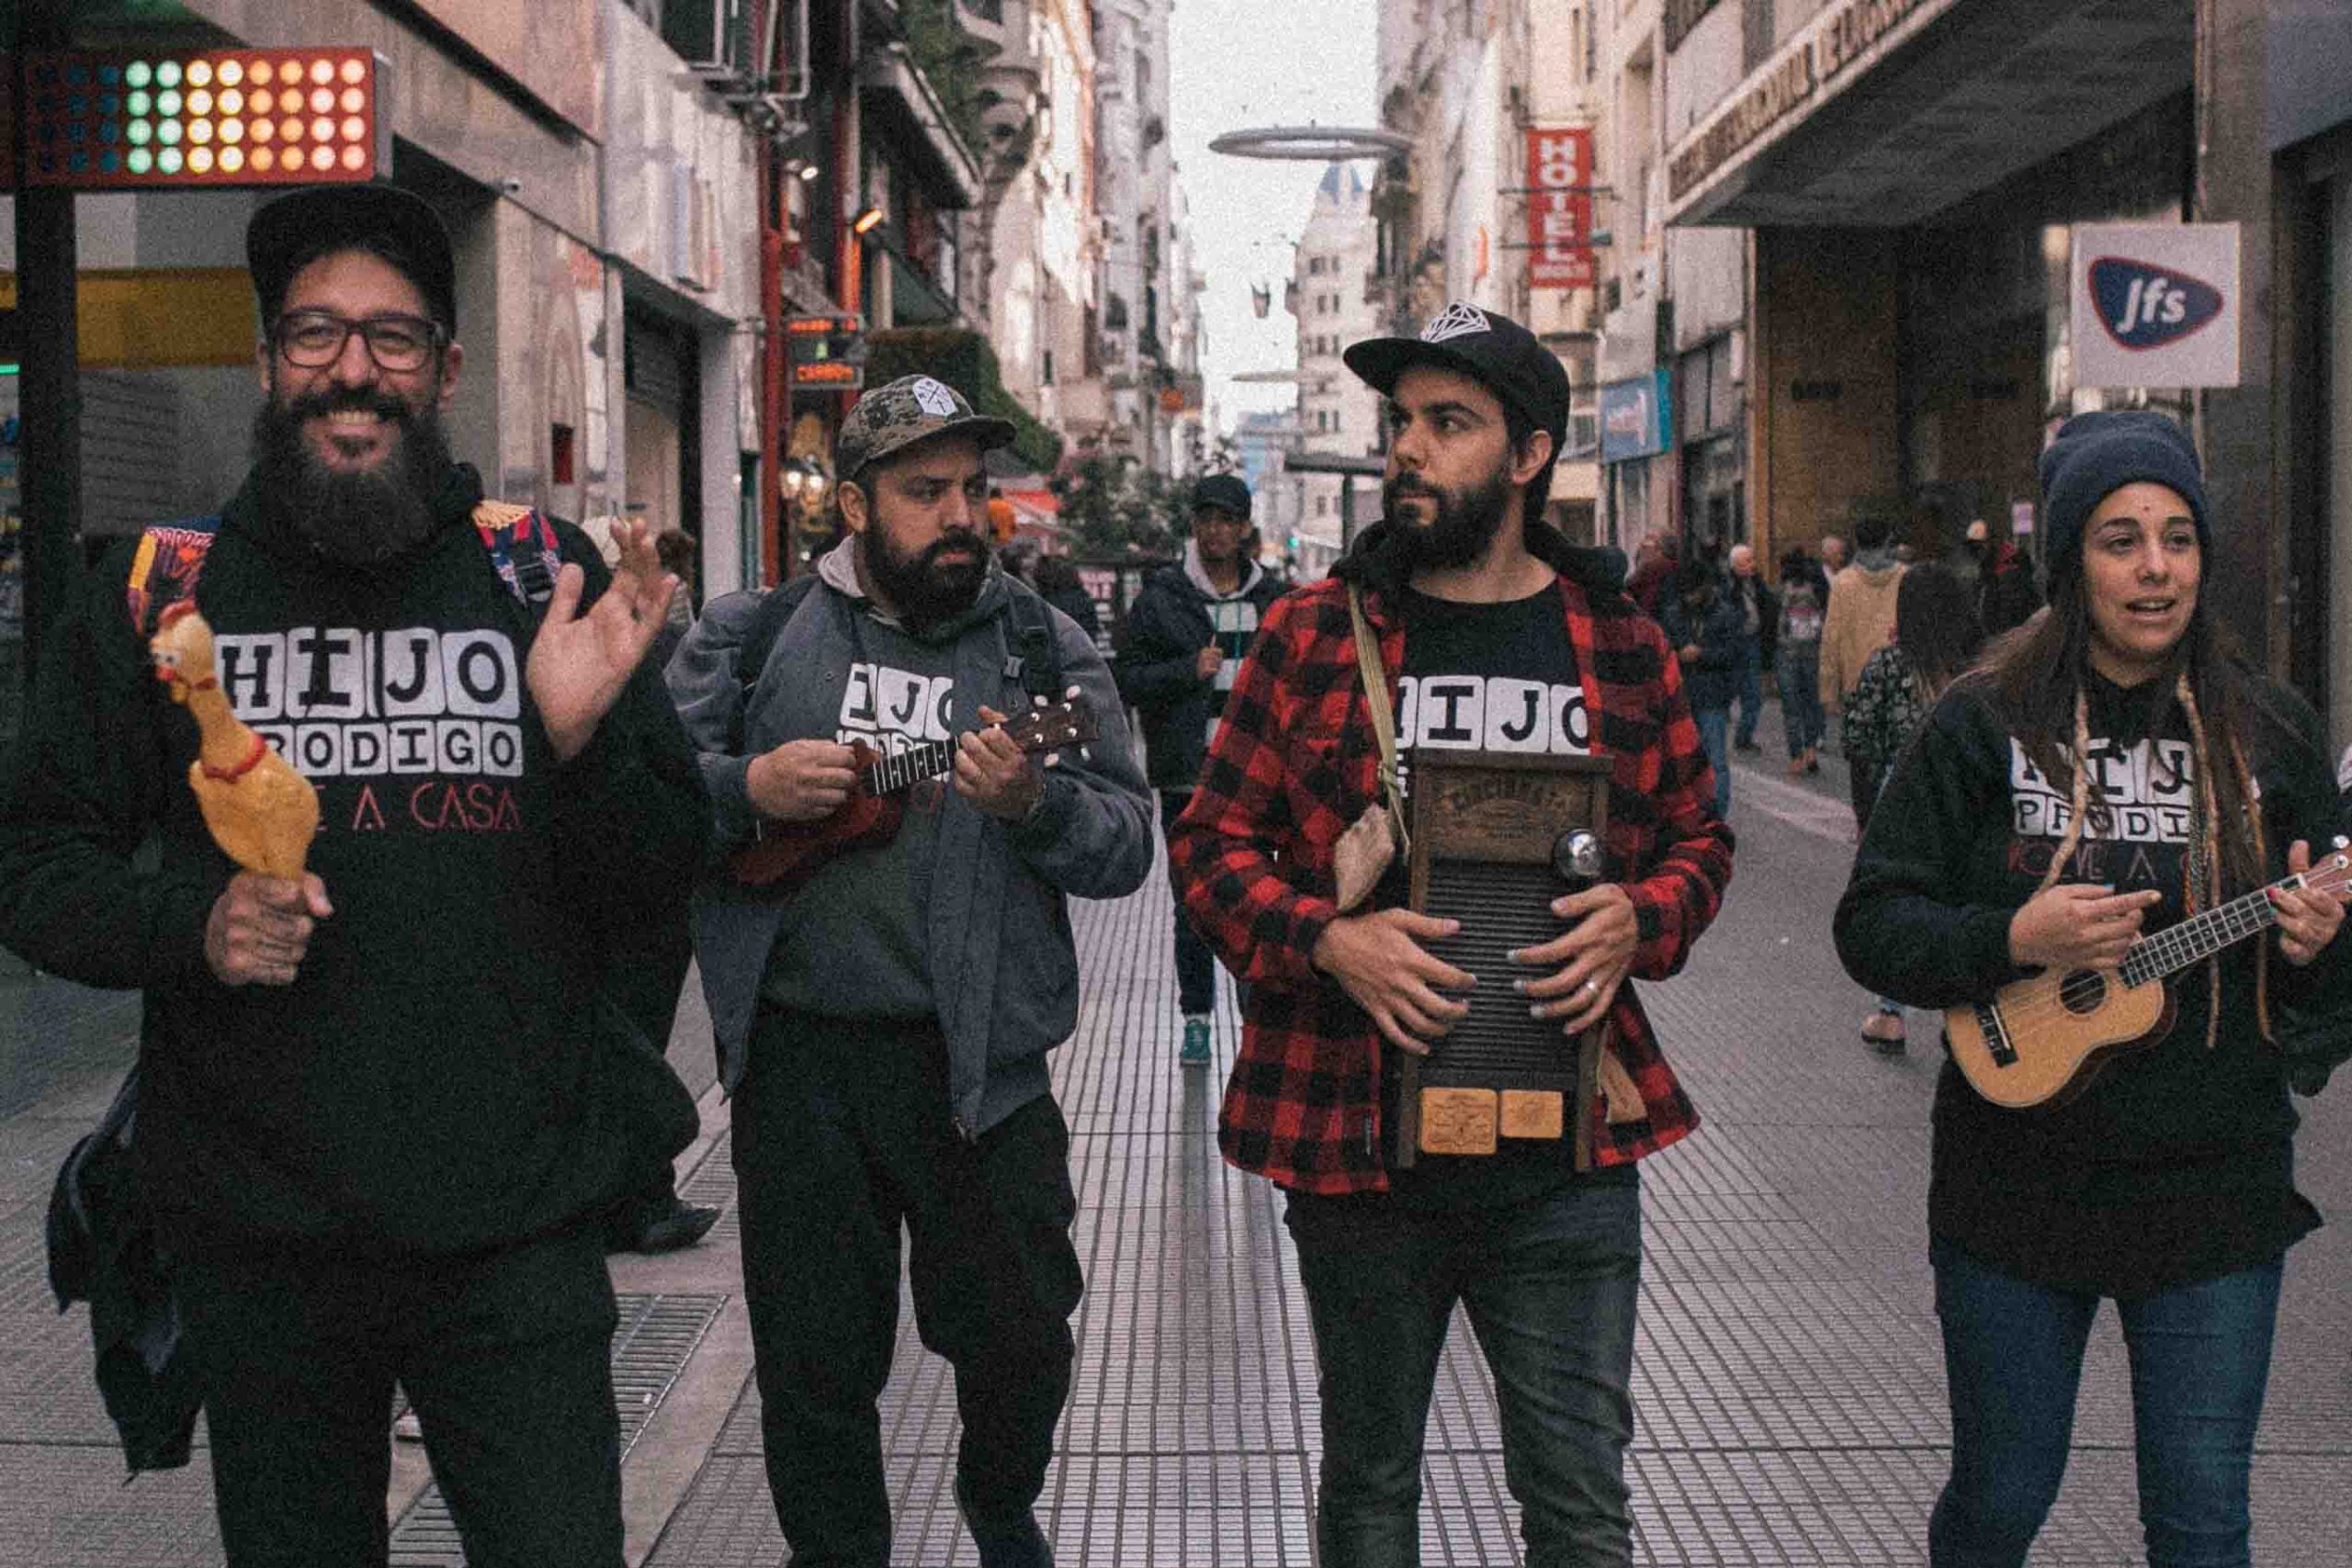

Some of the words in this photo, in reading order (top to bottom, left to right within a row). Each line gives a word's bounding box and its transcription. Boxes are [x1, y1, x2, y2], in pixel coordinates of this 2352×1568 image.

[1539, 137, 1577, 262] HOTEL
[220, 637, 506, 707] HIJO
[352, 783, 386, 830] A
[411, 782, 522, 830] CASA
